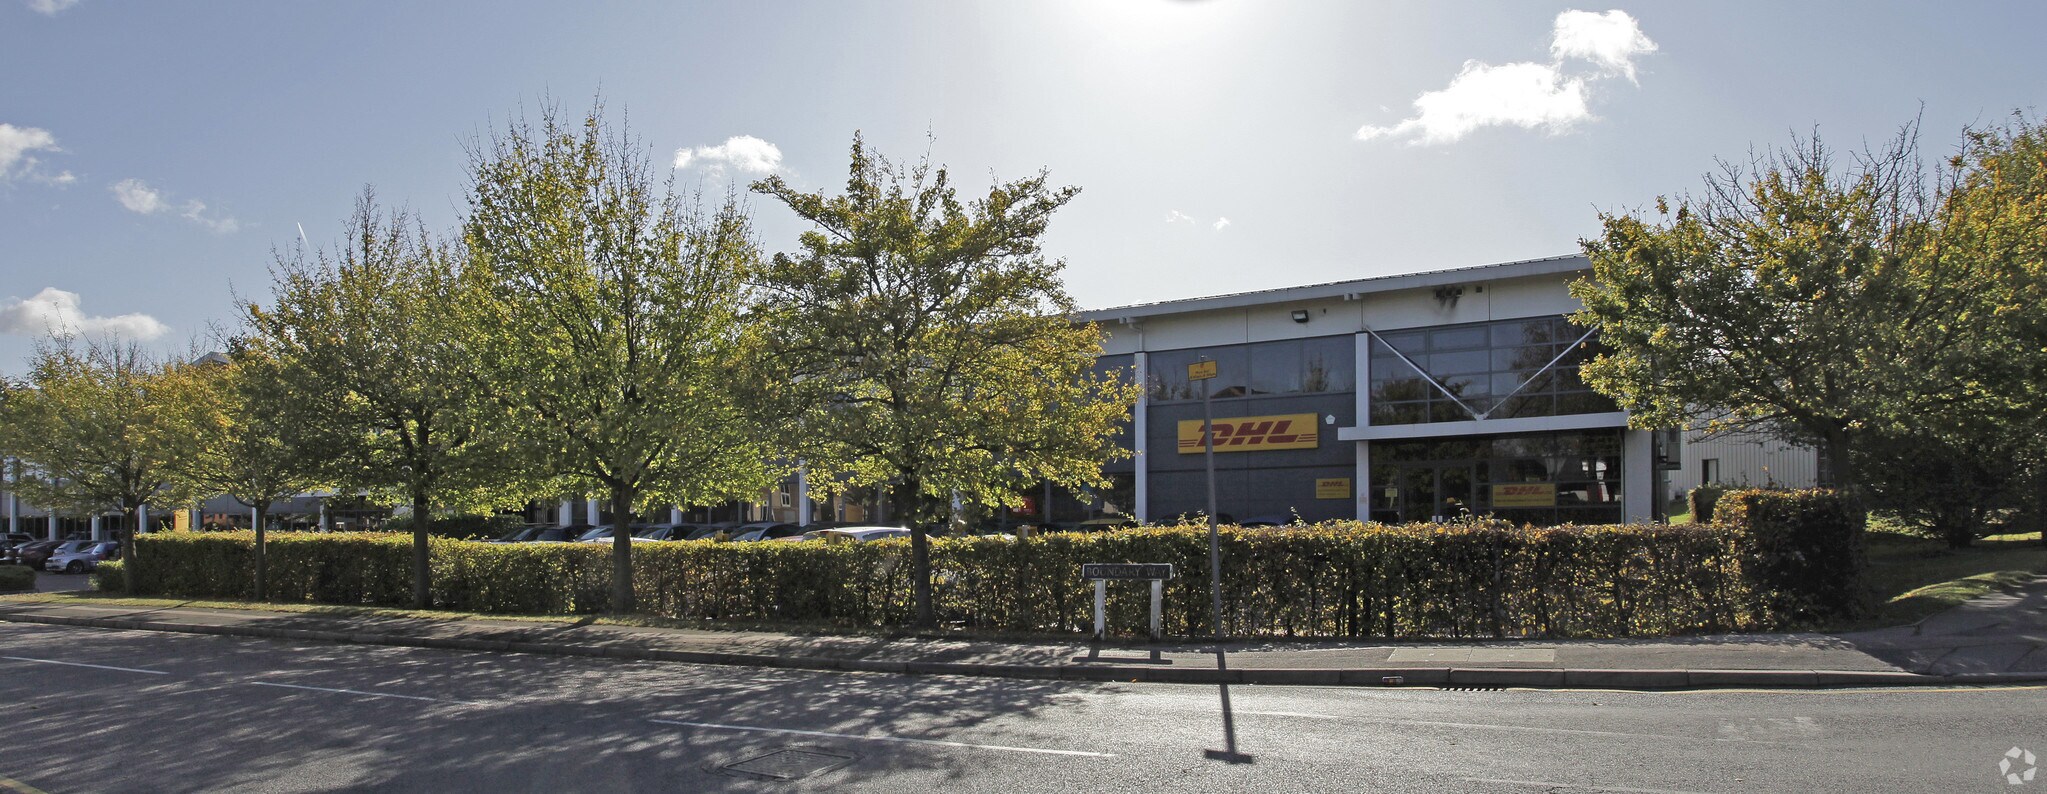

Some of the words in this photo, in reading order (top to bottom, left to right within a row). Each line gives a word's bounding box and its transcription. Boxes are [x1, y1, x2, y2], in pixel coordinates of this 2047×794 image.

[1196, 420, 1299, 446] DHL
[1504, 486, 1544, 496] DHL
[1086, 566, 1141, 577] BOUNDARY
[1146, 566, 1167, 577] WAY
